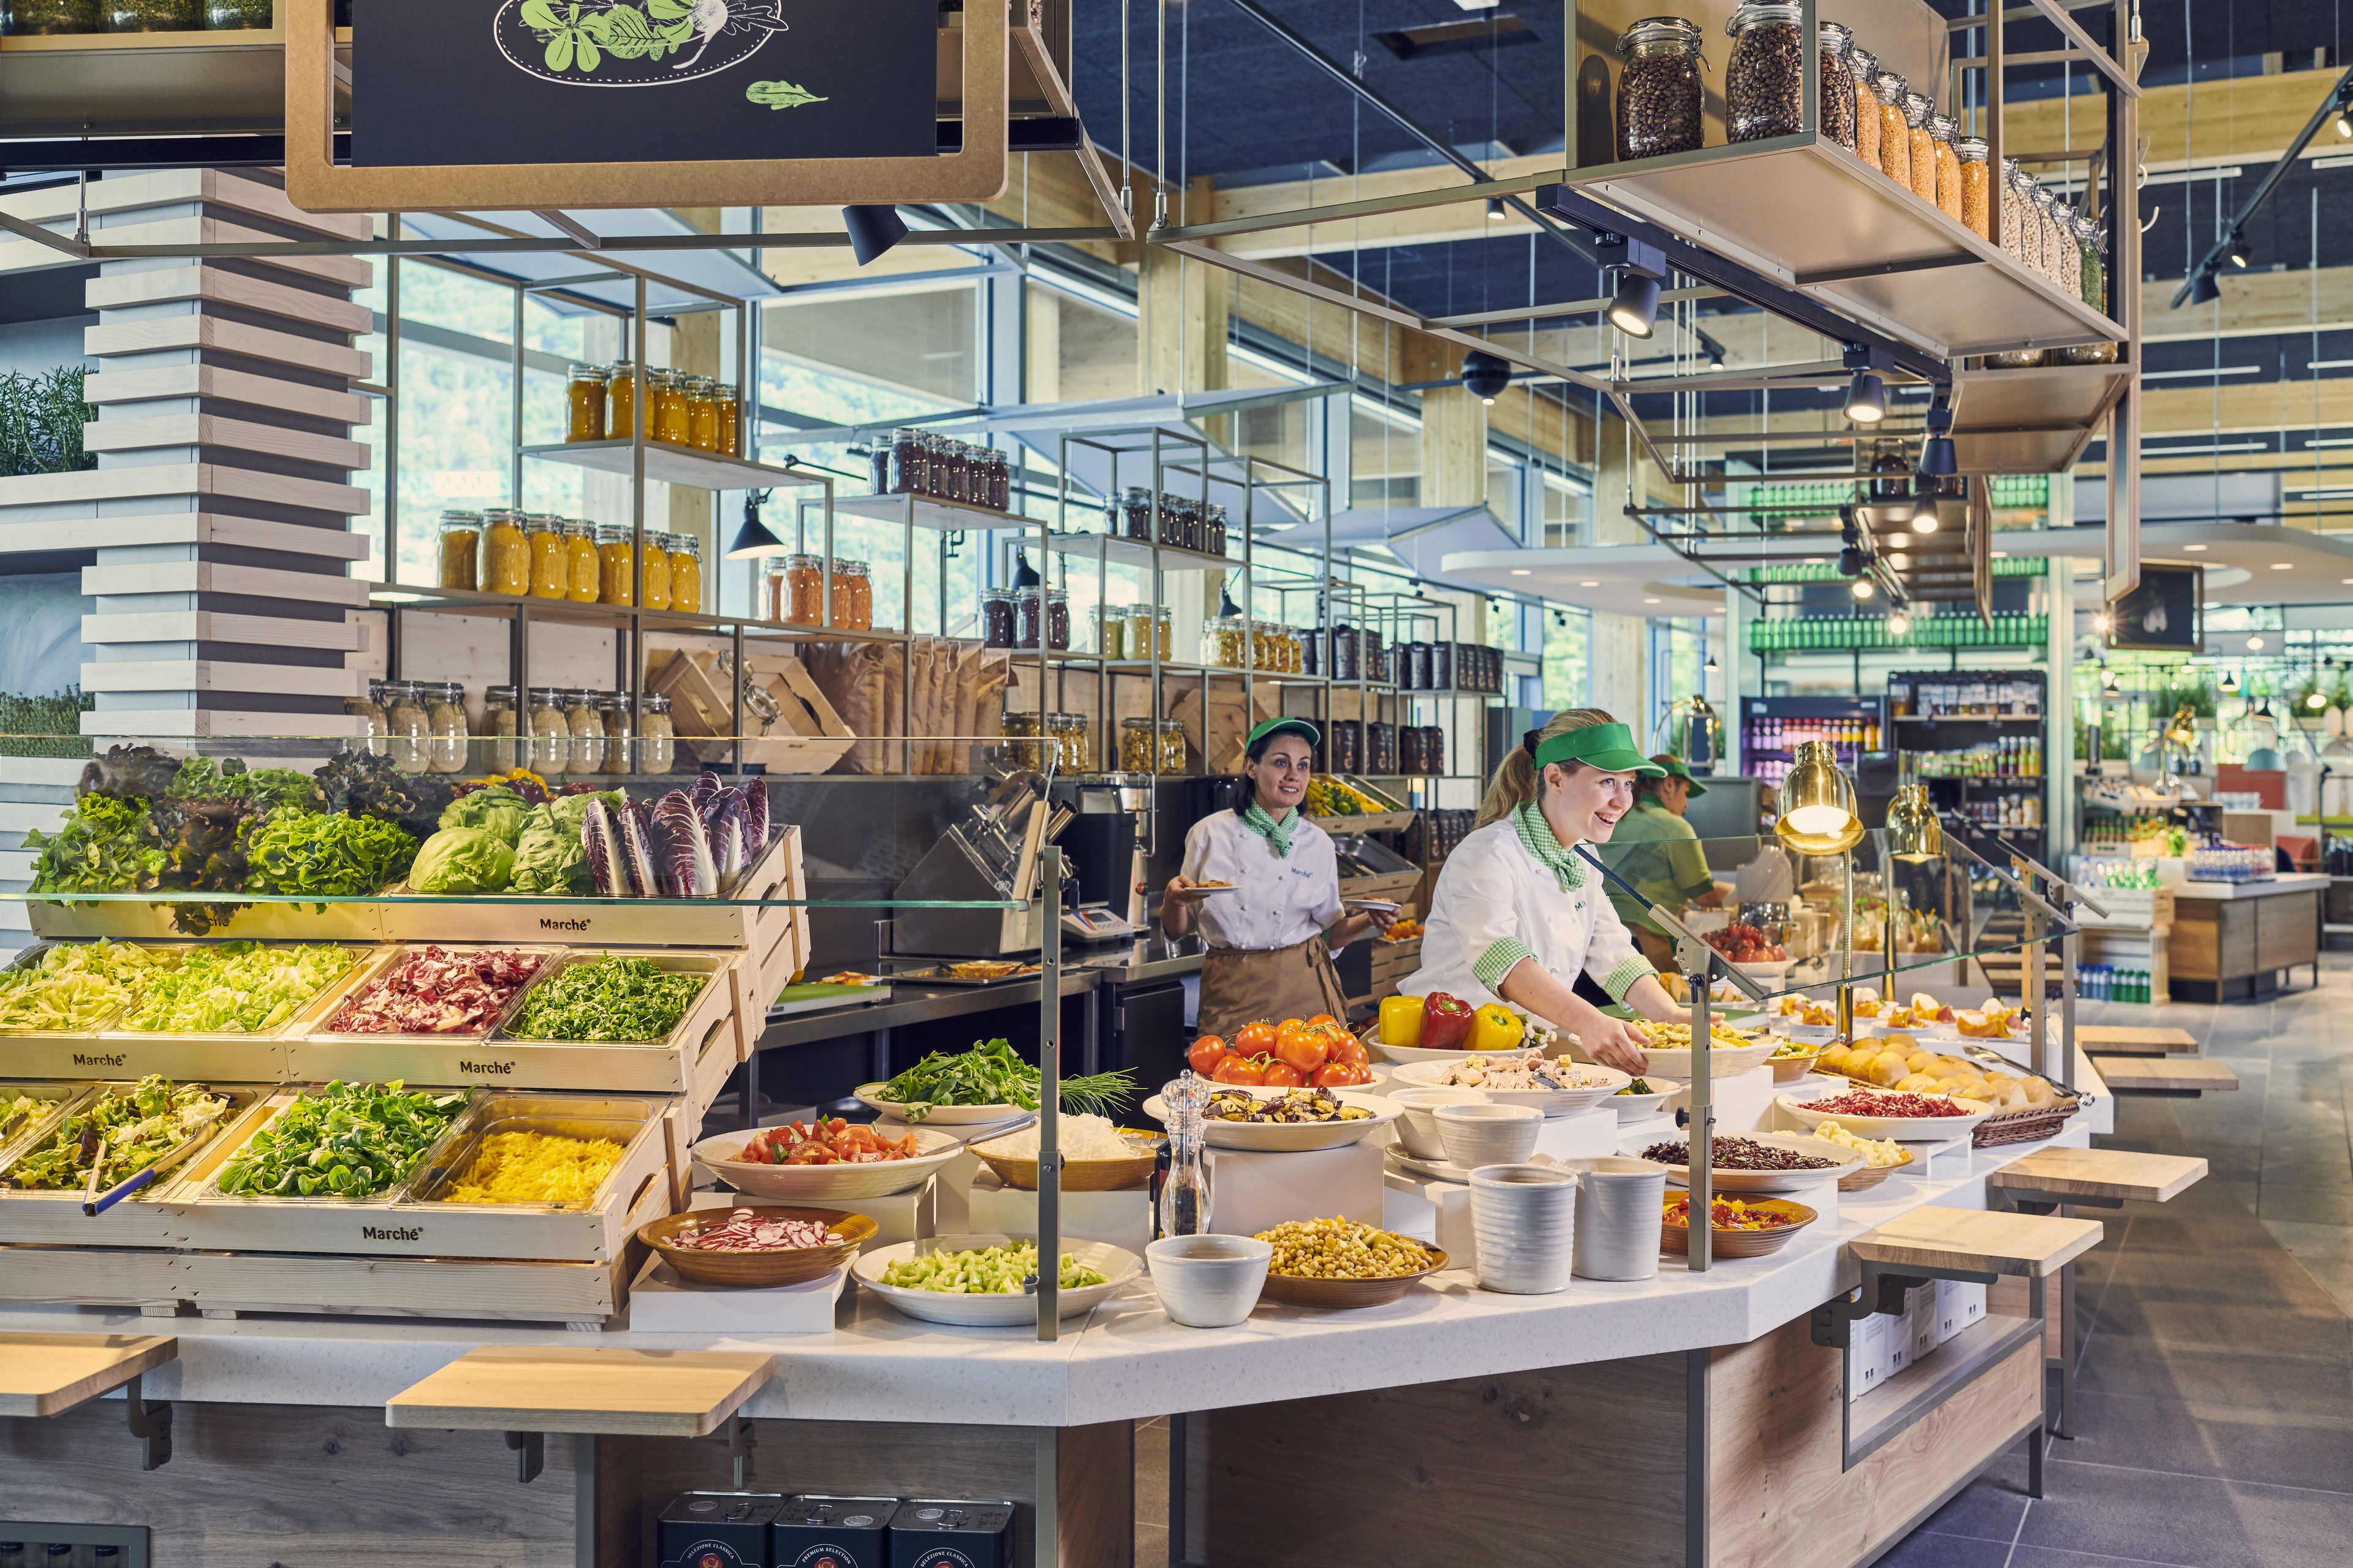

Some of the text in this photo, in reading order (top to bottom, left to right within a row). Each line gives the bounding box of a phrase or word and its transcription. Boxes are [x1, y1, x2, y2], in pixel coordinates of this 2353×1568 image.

[687, 1543, 734, 1559] SELEZIONE CLASSICA
[802, 1547, 852, 1564] PREMIUM SELECTION
[920, 1551, 968, 1567] SELEZIONE CLASSICA
